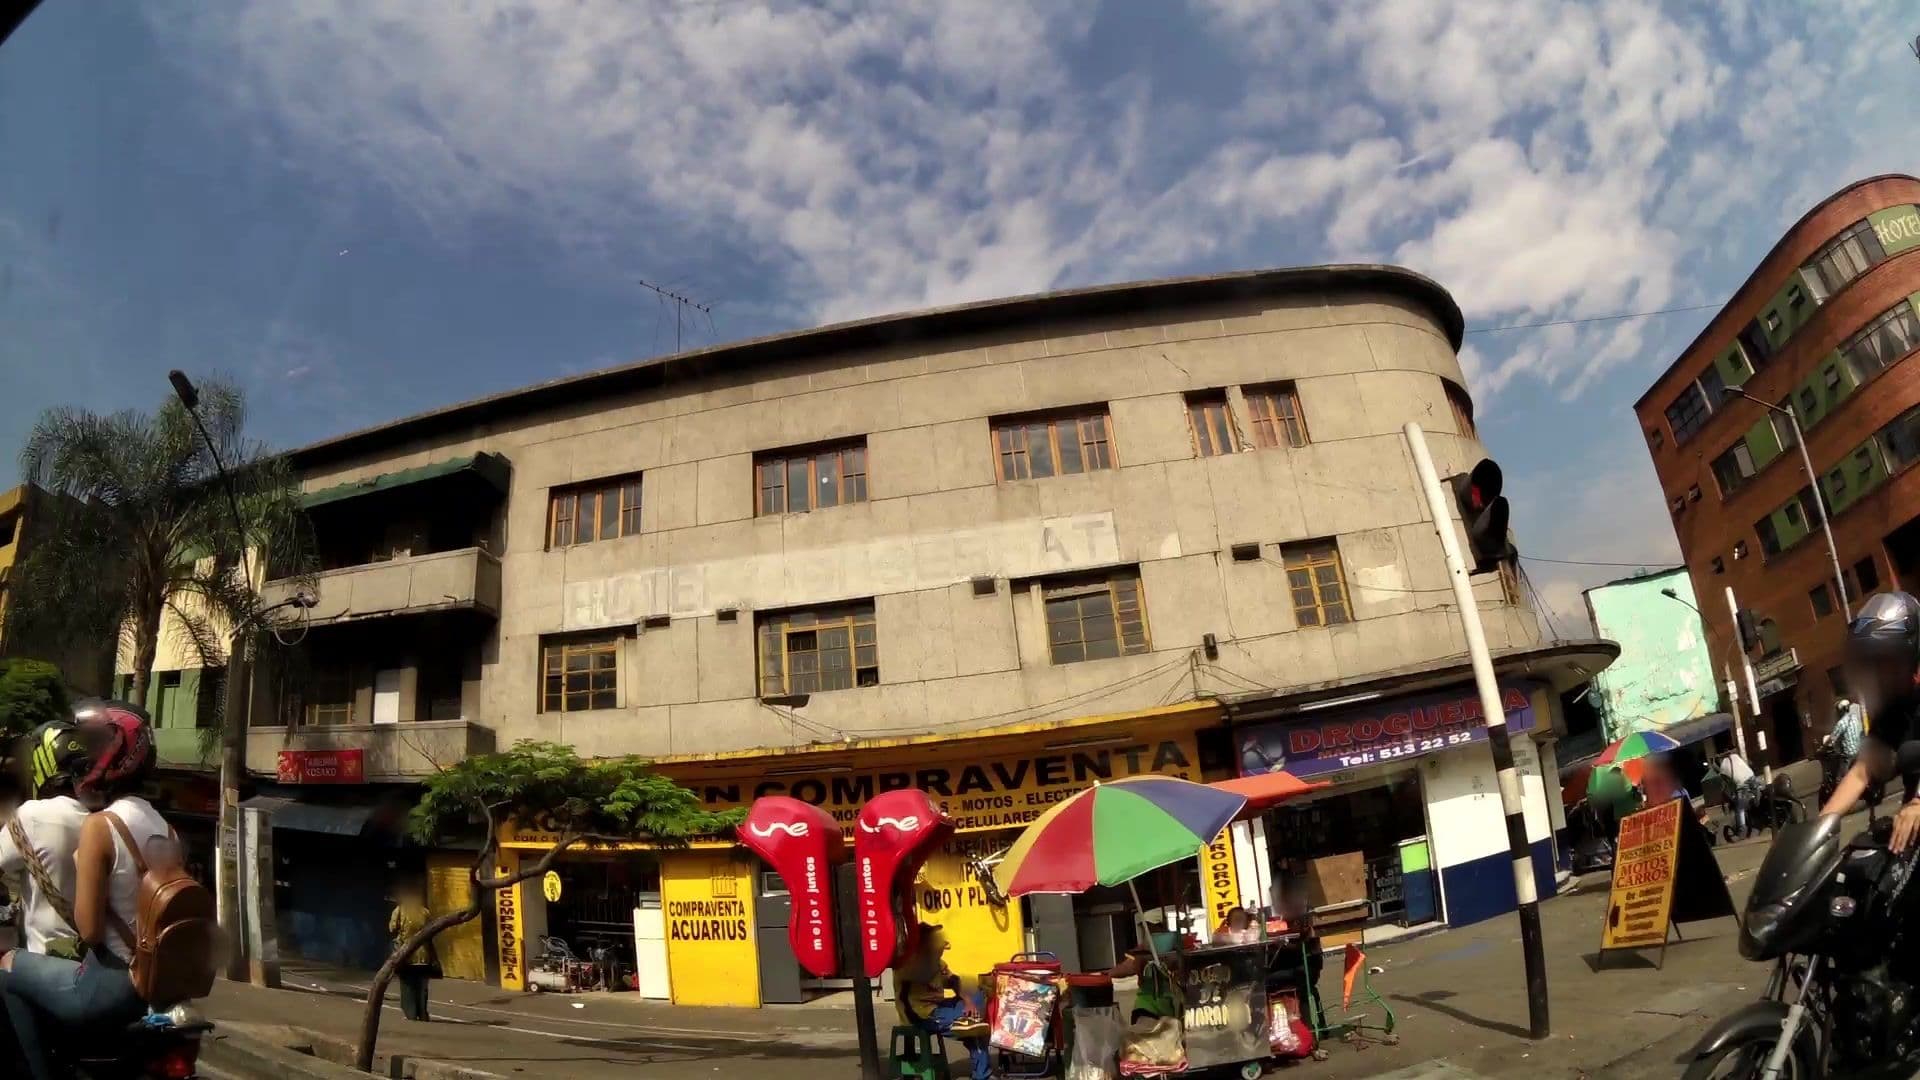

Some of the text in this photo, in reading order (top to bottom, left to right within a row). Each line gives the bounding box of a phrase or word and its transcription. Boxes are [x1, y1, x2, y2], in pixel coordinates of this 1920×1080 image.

[1290, 687, 1530, 753] DROGUERA
[1340, 753, 1375, 768] Tel:
[1380, 743, 1416, 760] 513
[1420, 737, 1444, 751] 22
[1449, 732, 1472, 745] 52
[962, 795, 1013, 812] MOTOS
[955, 809, 1041, 829] CELULARES
[1212, 862, 1231, 888] ORO
[1620, 855, 1669, 876] MOTOS
[1616, 868, 1669, 889] CARROS
[669, 900, 745, 917] COMPRAVENTA
[806, 856, 823, 951] mejor juntos
[862, 857, 879, 951] mejor juntos
[923, 888, 952, 911] ORO
[955, 887, 963, 908] Y
[671, 919, 747, 940] ACUARIUS
